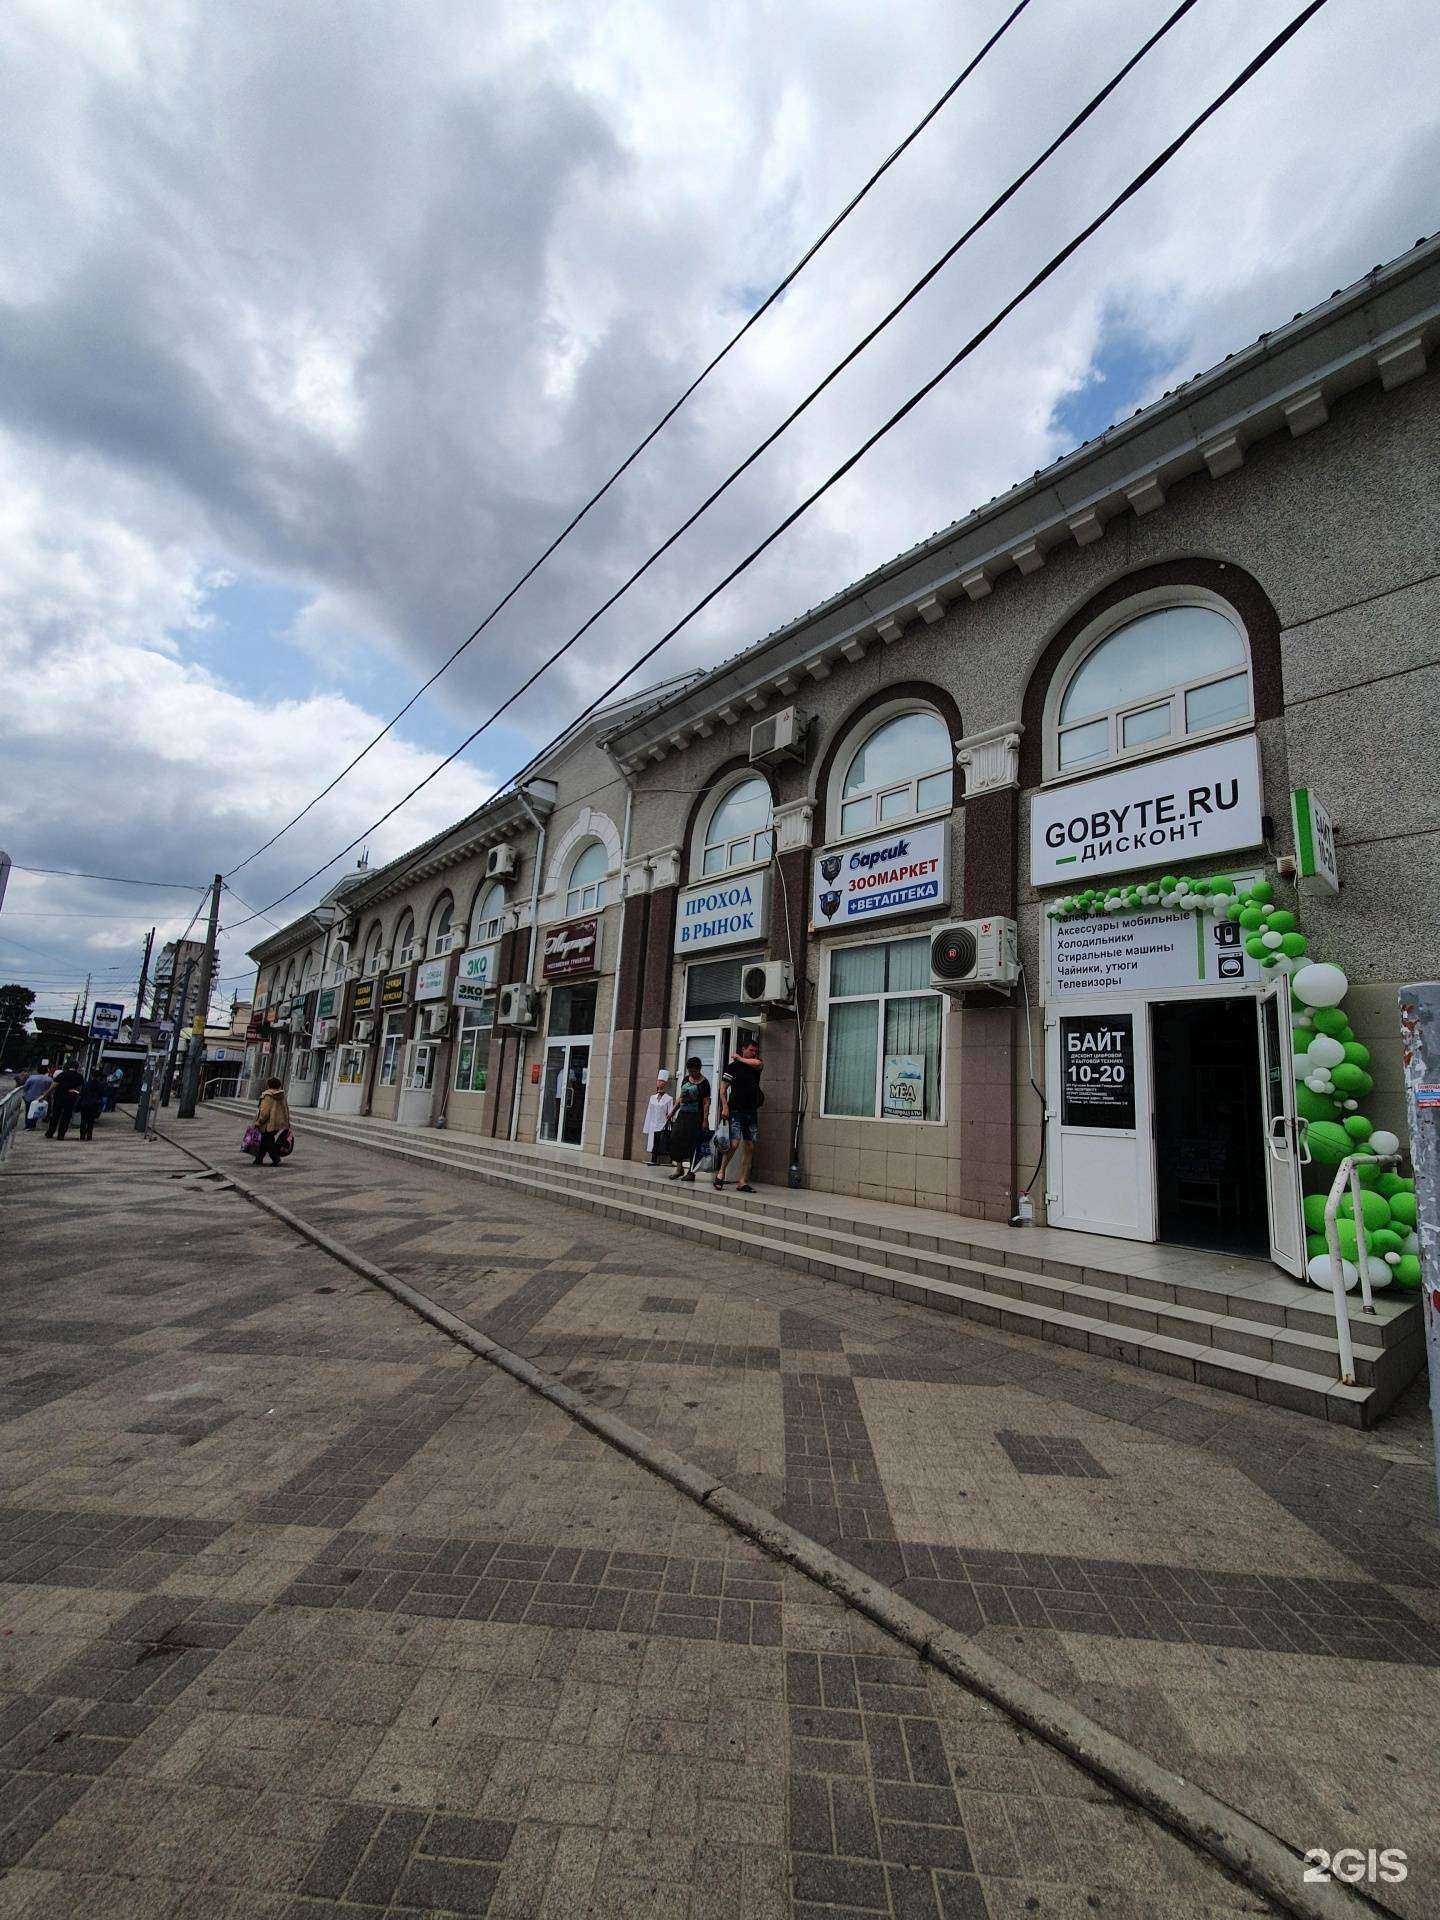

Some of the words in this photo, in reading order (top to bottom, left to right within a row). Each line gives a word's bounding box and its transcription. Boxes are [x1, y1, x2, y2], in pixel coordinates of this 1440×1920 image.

[1045, 778, 1239, 848] GOBYTE.RU
[1081, 820, 1203, 863] ДИСКОНТ
[849, 839, 912, 871] барсик
[847, 858, 939, 892] ЗООМАРКЕТ
[685, 886, 753, 916] ПРОХОД
[849, 884, 936, 912] +ВЕТАПТЕКА
[680, 925, 690, 942] В
[693, 912, 755, 940] РЫНОК
[1057, 922, 1119, 936] Аксессуары
[1122, 912, 1190, 928] мобильные
[1057, 933, 1134, 949] Холодильники
[1057, 948, 1122, 963] Стиральные
[1125, 943, 1174, 955] машины
[467, 955, 487, 976] ЭКО
[1057, 963, 1103, 976] Чайники,
[1105, 961, 1138, 974] утюги
[458, 984, 483, 996] ЭКО
[1057, 976, 1122, 990] Телевизоры
[458, 993, 482, 1002] МАРКЕТ
[1067, 1026, 1126, 1052] БАЙТ
[1068, 1065, 1125, 1082] 10-20
